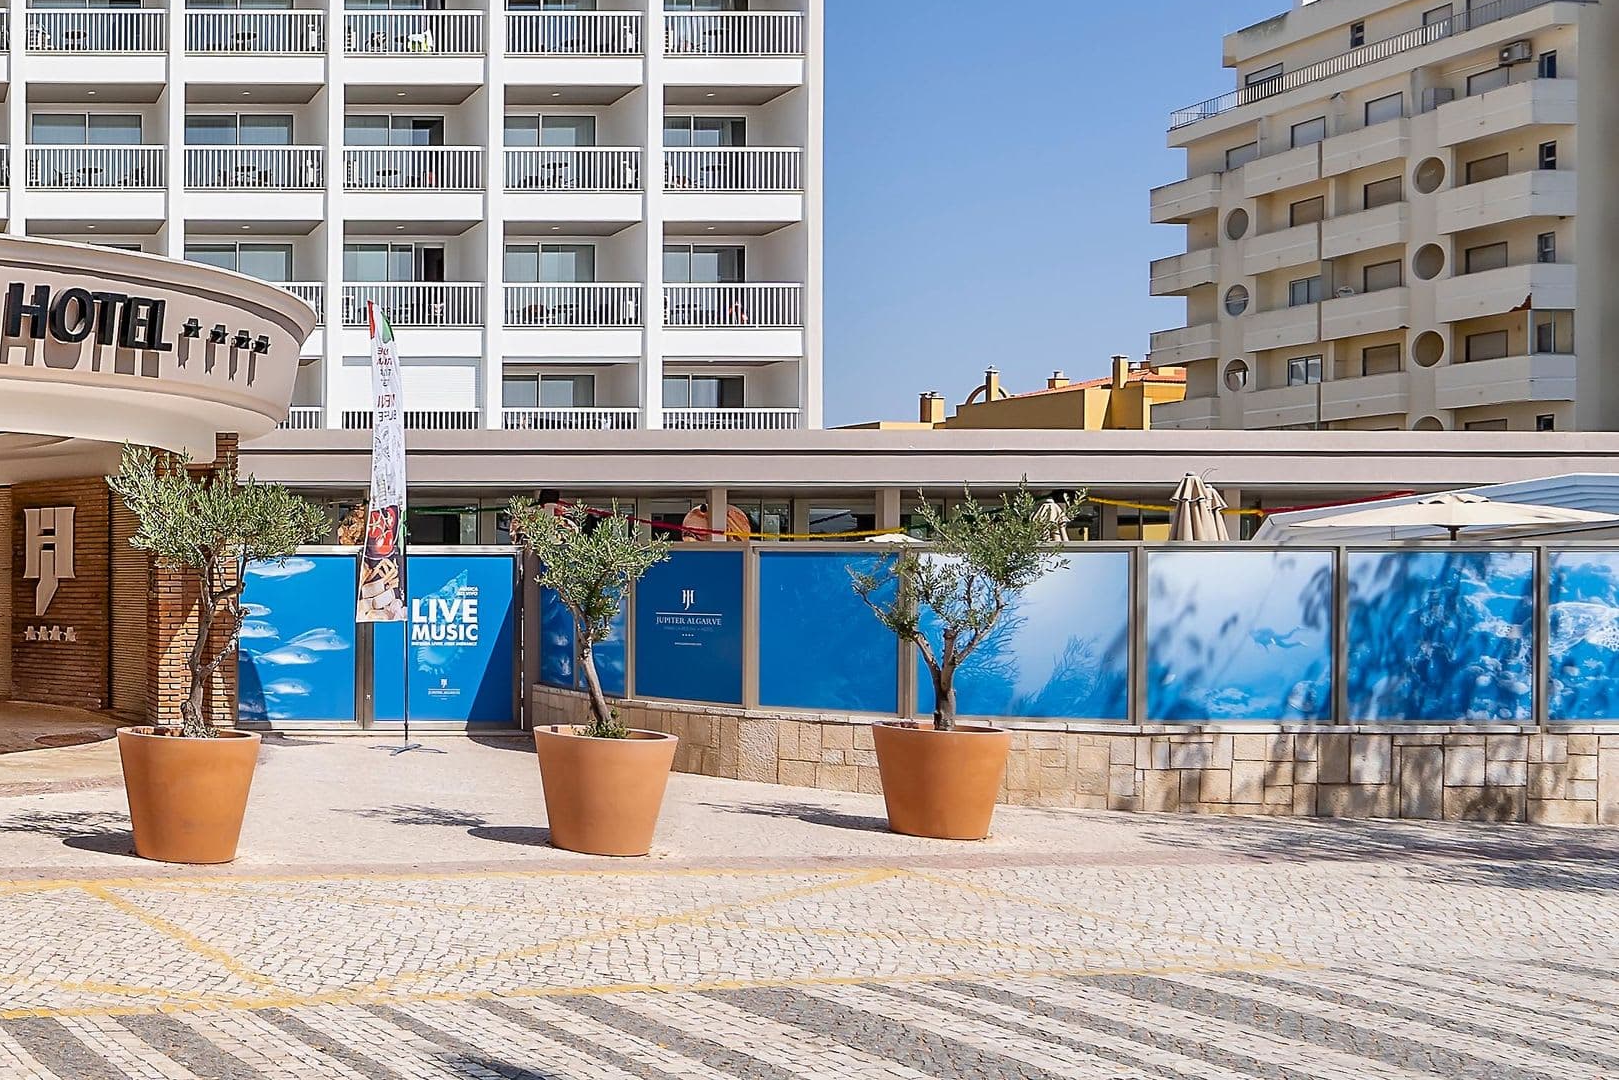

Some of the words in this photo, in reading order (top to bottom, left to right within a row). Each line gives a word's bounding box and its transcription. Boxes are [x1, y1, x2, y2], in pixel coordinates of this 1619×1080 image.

[4, 281, 172, 350] HOTEL
[412, 599, 478, 623] LIVE
[411, 623, 478, 641] MUSIC
[686, 618, 722, 626] ALGARVE
